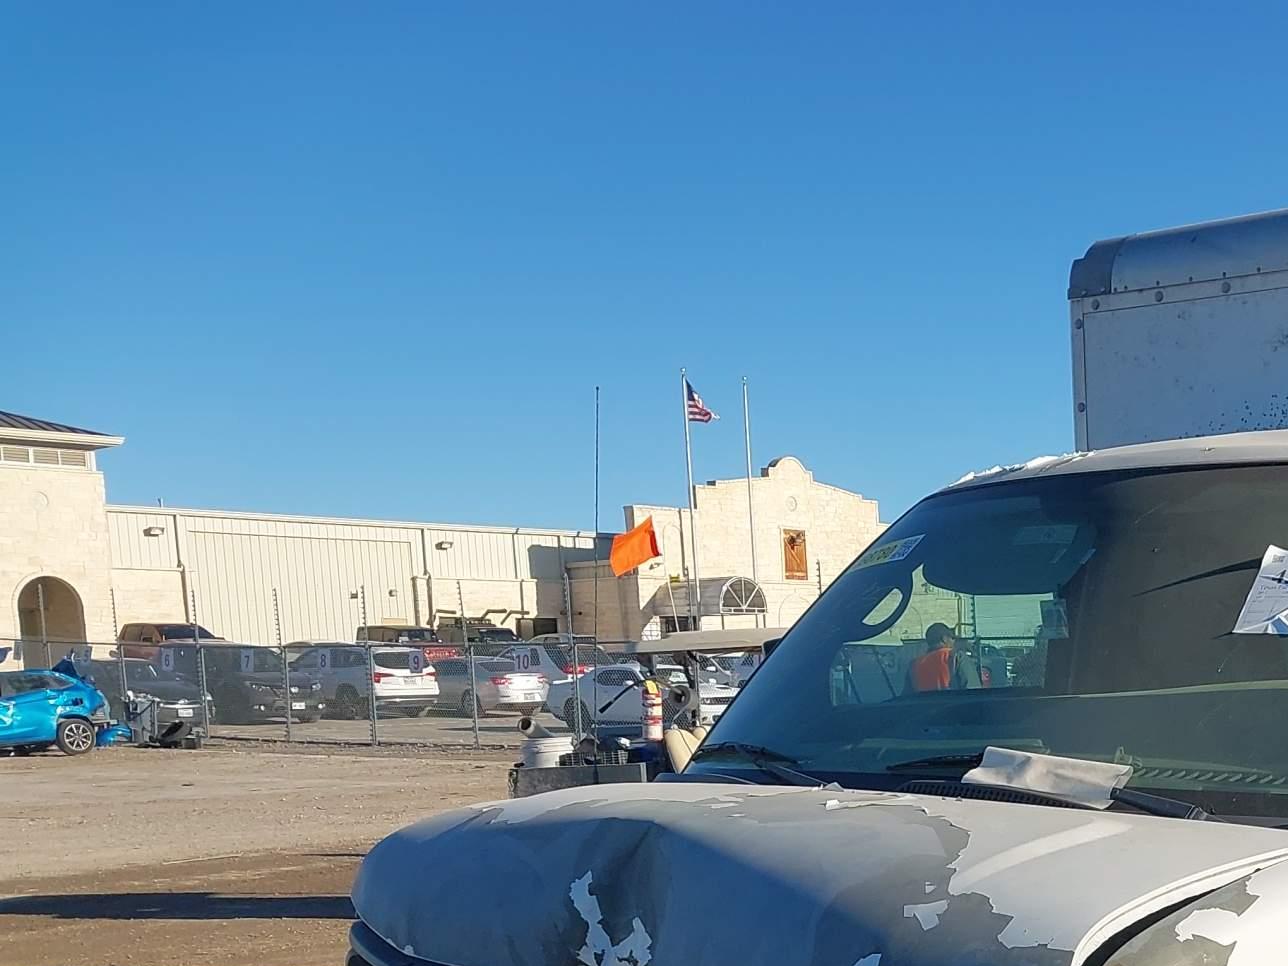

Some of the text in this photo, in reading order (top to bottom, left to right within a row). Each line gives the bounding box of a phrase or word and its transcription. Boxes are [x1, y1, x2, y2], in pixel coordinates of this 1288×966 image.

[164, 654, 170, 667] 6
[244, 655, 250, 668] 7
[320, 654, 326, 668] 8
[413, 654, 419, 671] 9
[515, 654, 529, 670] 10
